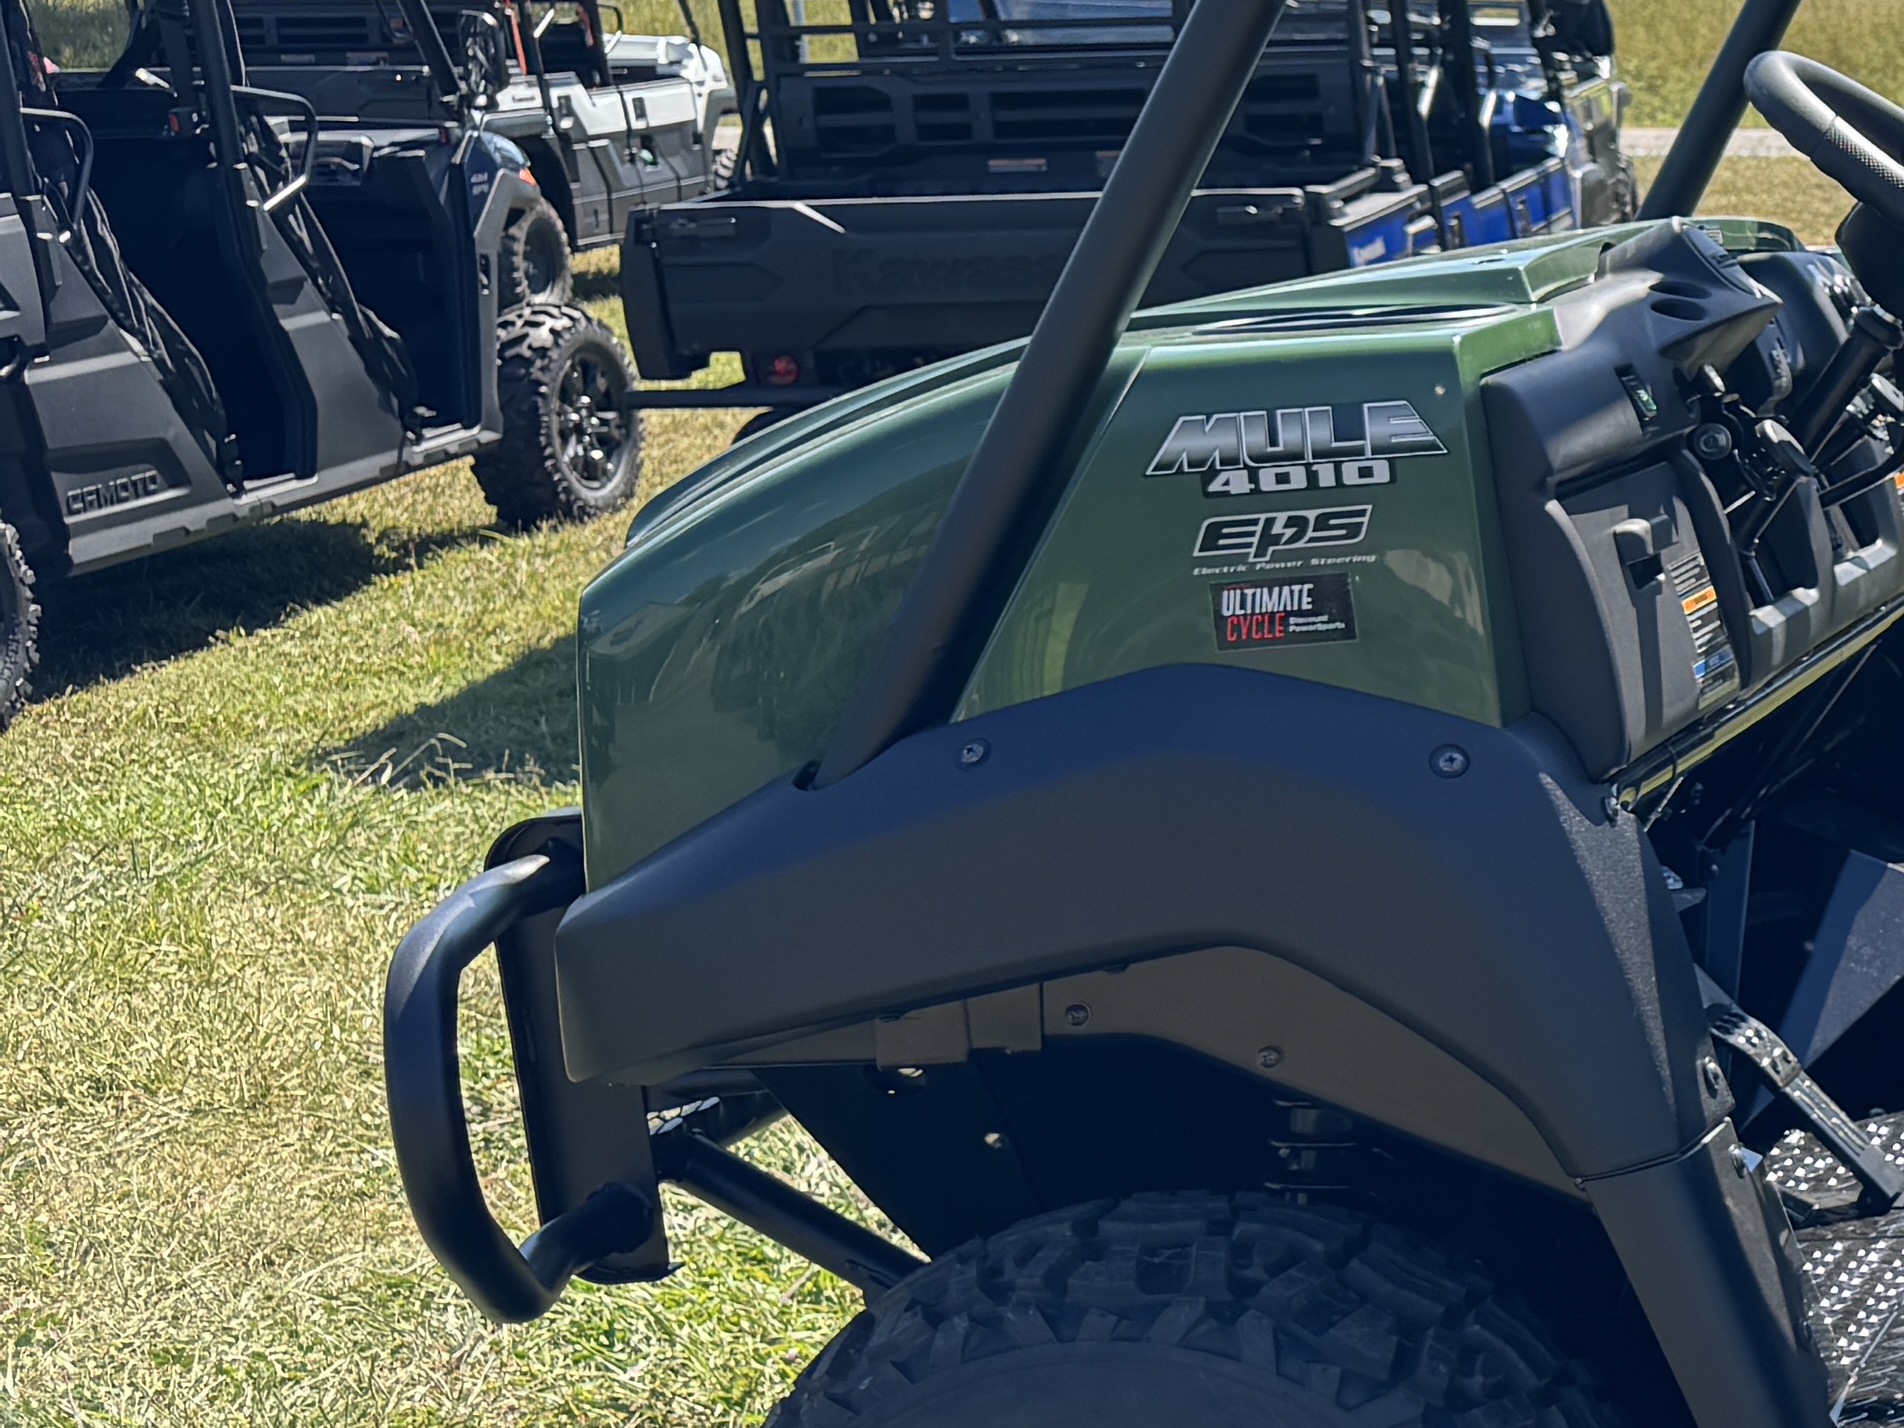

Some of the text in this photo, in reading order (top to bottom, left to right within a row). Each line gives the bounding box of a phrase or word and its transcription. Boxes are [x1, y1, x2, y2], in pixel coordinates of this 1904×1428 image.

[1145, 399, 1448, 476] MULE
[1207, 459, 1391, 496] 4010
[1193, 505, 1373, 562] EPS
[1256, 561, 1304, 571] Power
[1310, 554, 1377, 567] Steering
[1221, 583, 1314, 616] ULTIMATE
[1226, 612, 1286, 642] CYCLE
